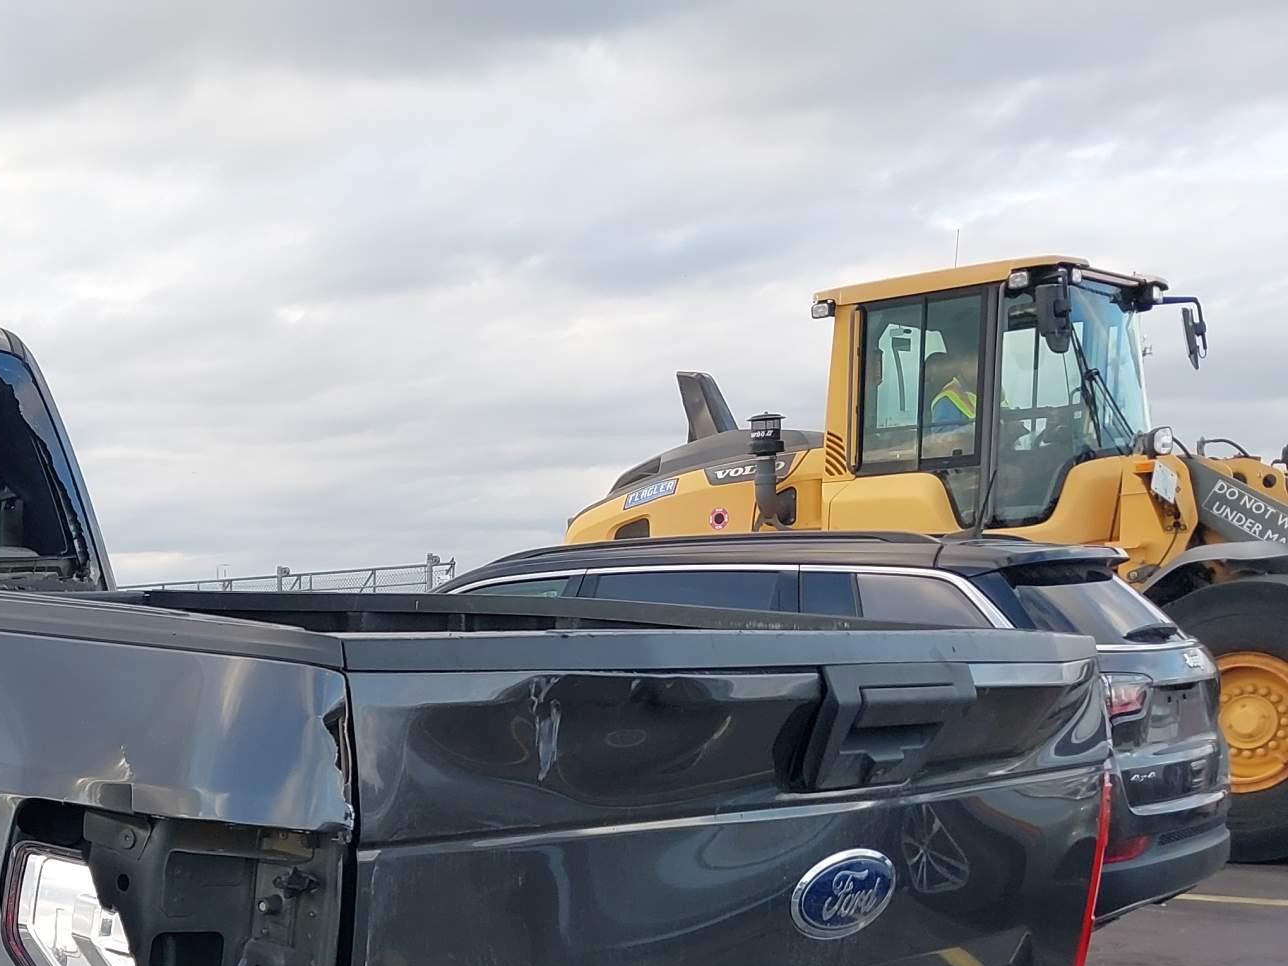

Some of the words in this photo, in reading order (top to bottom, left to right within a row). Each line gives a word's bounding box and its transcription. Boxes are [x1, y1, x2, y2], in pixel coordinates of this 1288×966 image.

[714, 461, 785, 479] VOLO
[1215, 480, 1239, 500] DO
[1239, 495, 1277, 519] NOT
[1212, 501, 1263, 537] UNDER
[822, 868, 881, 921] Ford
